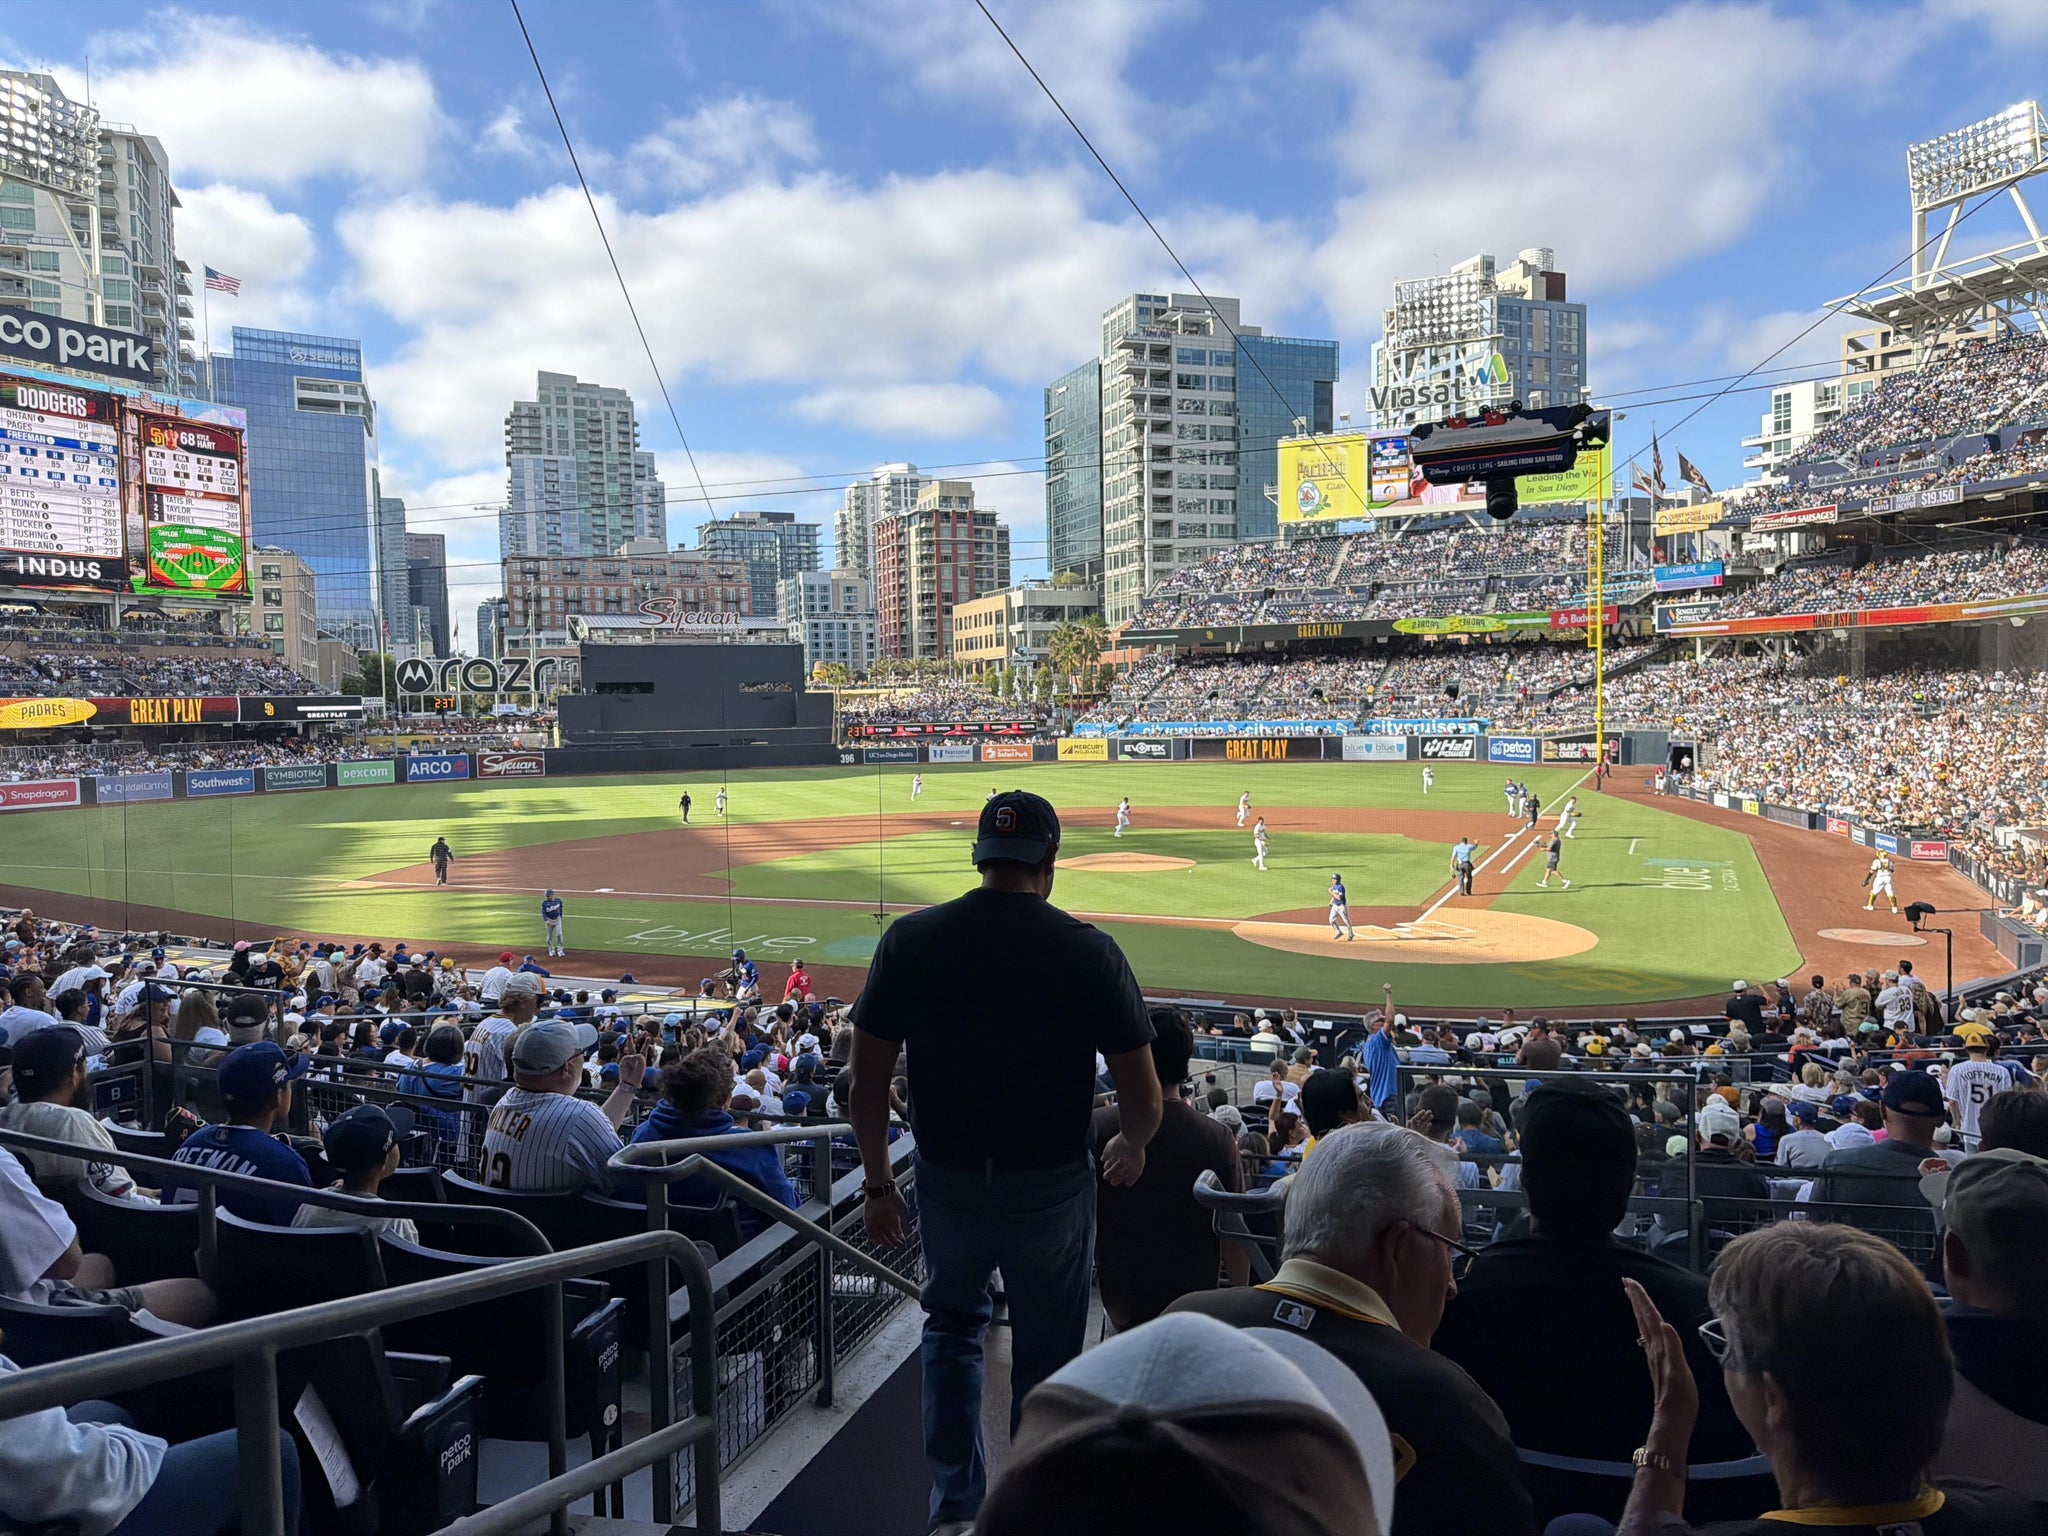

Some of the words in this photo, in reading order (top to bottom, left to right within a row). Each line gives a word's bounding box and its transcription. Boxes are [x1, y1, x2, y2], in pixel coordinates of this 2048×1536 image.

[58, 327, 150, 372] park
[309, 354, 358, 366] SEMPRA
[1370, 378, 1466, 410] Viasat
[17, 386, 87, 417] DODGERS
[6, 410, 36, 422] OHTANI
[78, 422, 88, 430] DH
[6, 421, 33, 432] PAGES
[79, 432, 88, 440] CF
[7, 430, 46, 443] FREEMAN
[80, 441, 88, 450] 1B
[98, 445, 114, 454] .286
[180, 432, 196, 446] 68
[197, 440, 216, 450] HART
[24, 457, 34, 465] 45
[100, 468, 115, 476] .492
[152, 460, 162, 468] 0-1
[175, 463, 188, 471] 4.01
[198, 466, 212, 474] 2.86
[221, 470, 234, 478] 24.2
[1427, 468, 1450, 476] Disney
[1452, 464, 1476, 472] CRUISE
[1479, 462, 1493, 470] LINE
[1497, 458, 1518, 468] SAILING
[1519, 457, 1534, 466] FROM
[1535, 456, 1546, 464] SAN
[1546, 454, 1564, 462] DIEGO
[151, 476, 166, 484] 11/11
[1526, 473, 1564, 484] Leading
[1566, 472, 1580, 480] the
[78, 484, 88, 492] 43
[1526, 486, 1536, 494] in
[1537, 484, 1554, 492] San
[1556, 484, 1578, 493] Diego
[10, 488, 35, 498] BETTS
[102, 500, 115, 508] .231
[166, 496, 184, 505] TATIS
[225, 504, 238, 512] .285
[1896, 494, 1916, 503] TODAY'S
[11, 499, 40, 509] MUNCY
[82, 507, 92, 515] 3B
[102, 510, 116, 518] .263
[166, 505, 191, 514] TAYLOR
[226, 512, 238, 520] .361
[1896, 501, 1916, 510] JACKPOT
[12, 509, 40, 519] EDMAN
[166, 514, 196, 524] MERRILL
[1668, 512, 1684, 521] CURRY
[1686, 510, 1702, 518] HOUSE
[1797, 511, 1834, 524] SAUSAGES
[12, 519, 44, 530] TUCKER
[12, 529, 48, 540] RUSHING
[86, 536, 92, 544] C
[103, 538, 118, 546] .239
[158, 529, 178, 538] TAYLOR
[184, 528, 208, 536] MERRILL
[13, 539, 54, 550] FREELAND
[84, 546, 94, 554] 2B
[104, 548, 118, 556] .236
[204, 545, 227, 553] WAGNER
[156, 552, 183, 560] MACHADO
[18, 557, 102, 580] INDUS
[638, 596, 741, 634] Sycuan
[1676, 606, 1710, 615] SINGLETON
[1298, 625, 1320, 638] GREAT
[1324, 624, 1343, 636] PLAY
[439, 657, 558, 693] razr
[434, 698, 454, 709] 2:37
[21, 704, 66, 720] PADRES
[130, 699, 170, 724] GREAT
[173, 698, 203, 722] PLAY
[848, 727, 864, 738] 2:37
[1226, 740, 1258, 760] GREAT
[1262, 739, 1288, 760] PLAY
[1440, 740, 1474, 750] H2O
[1504, 742, 1531, 755] petco
[1558, 743, 1578, 751] SLAP
[840, 754, 854, 764] 396
[887, 752, 900, 760] Diego
[1438, 750, 1471, 758] POWER
[409, 762, 452, 776] ARCO
[483, 756, 538, 775] Sycuan
[267, 769, 324, 780] CYMBIOTIKA
[114, 782, 168, 793] QuidelOrtho
[191, 776, 244, 789] Southwest
[10, 788, 68, 800] Snapdragon
[624, 924, 818, 948] blue
[1861, 1002, 1868, 1015] 3
[1899, 997, 1911, 1012] 23
[1961, 1070, 2003, 1084] HOFFMAN
[111, 1086, 121, 1100] B
[1970, 1084, 1993, 1104] 51
[598, 1342, 618, 1367] petco
[602, 1351, 619, 1373] park
[440, 1434, 471, 1468] petco
[447, 1445, 472, 1476] park
